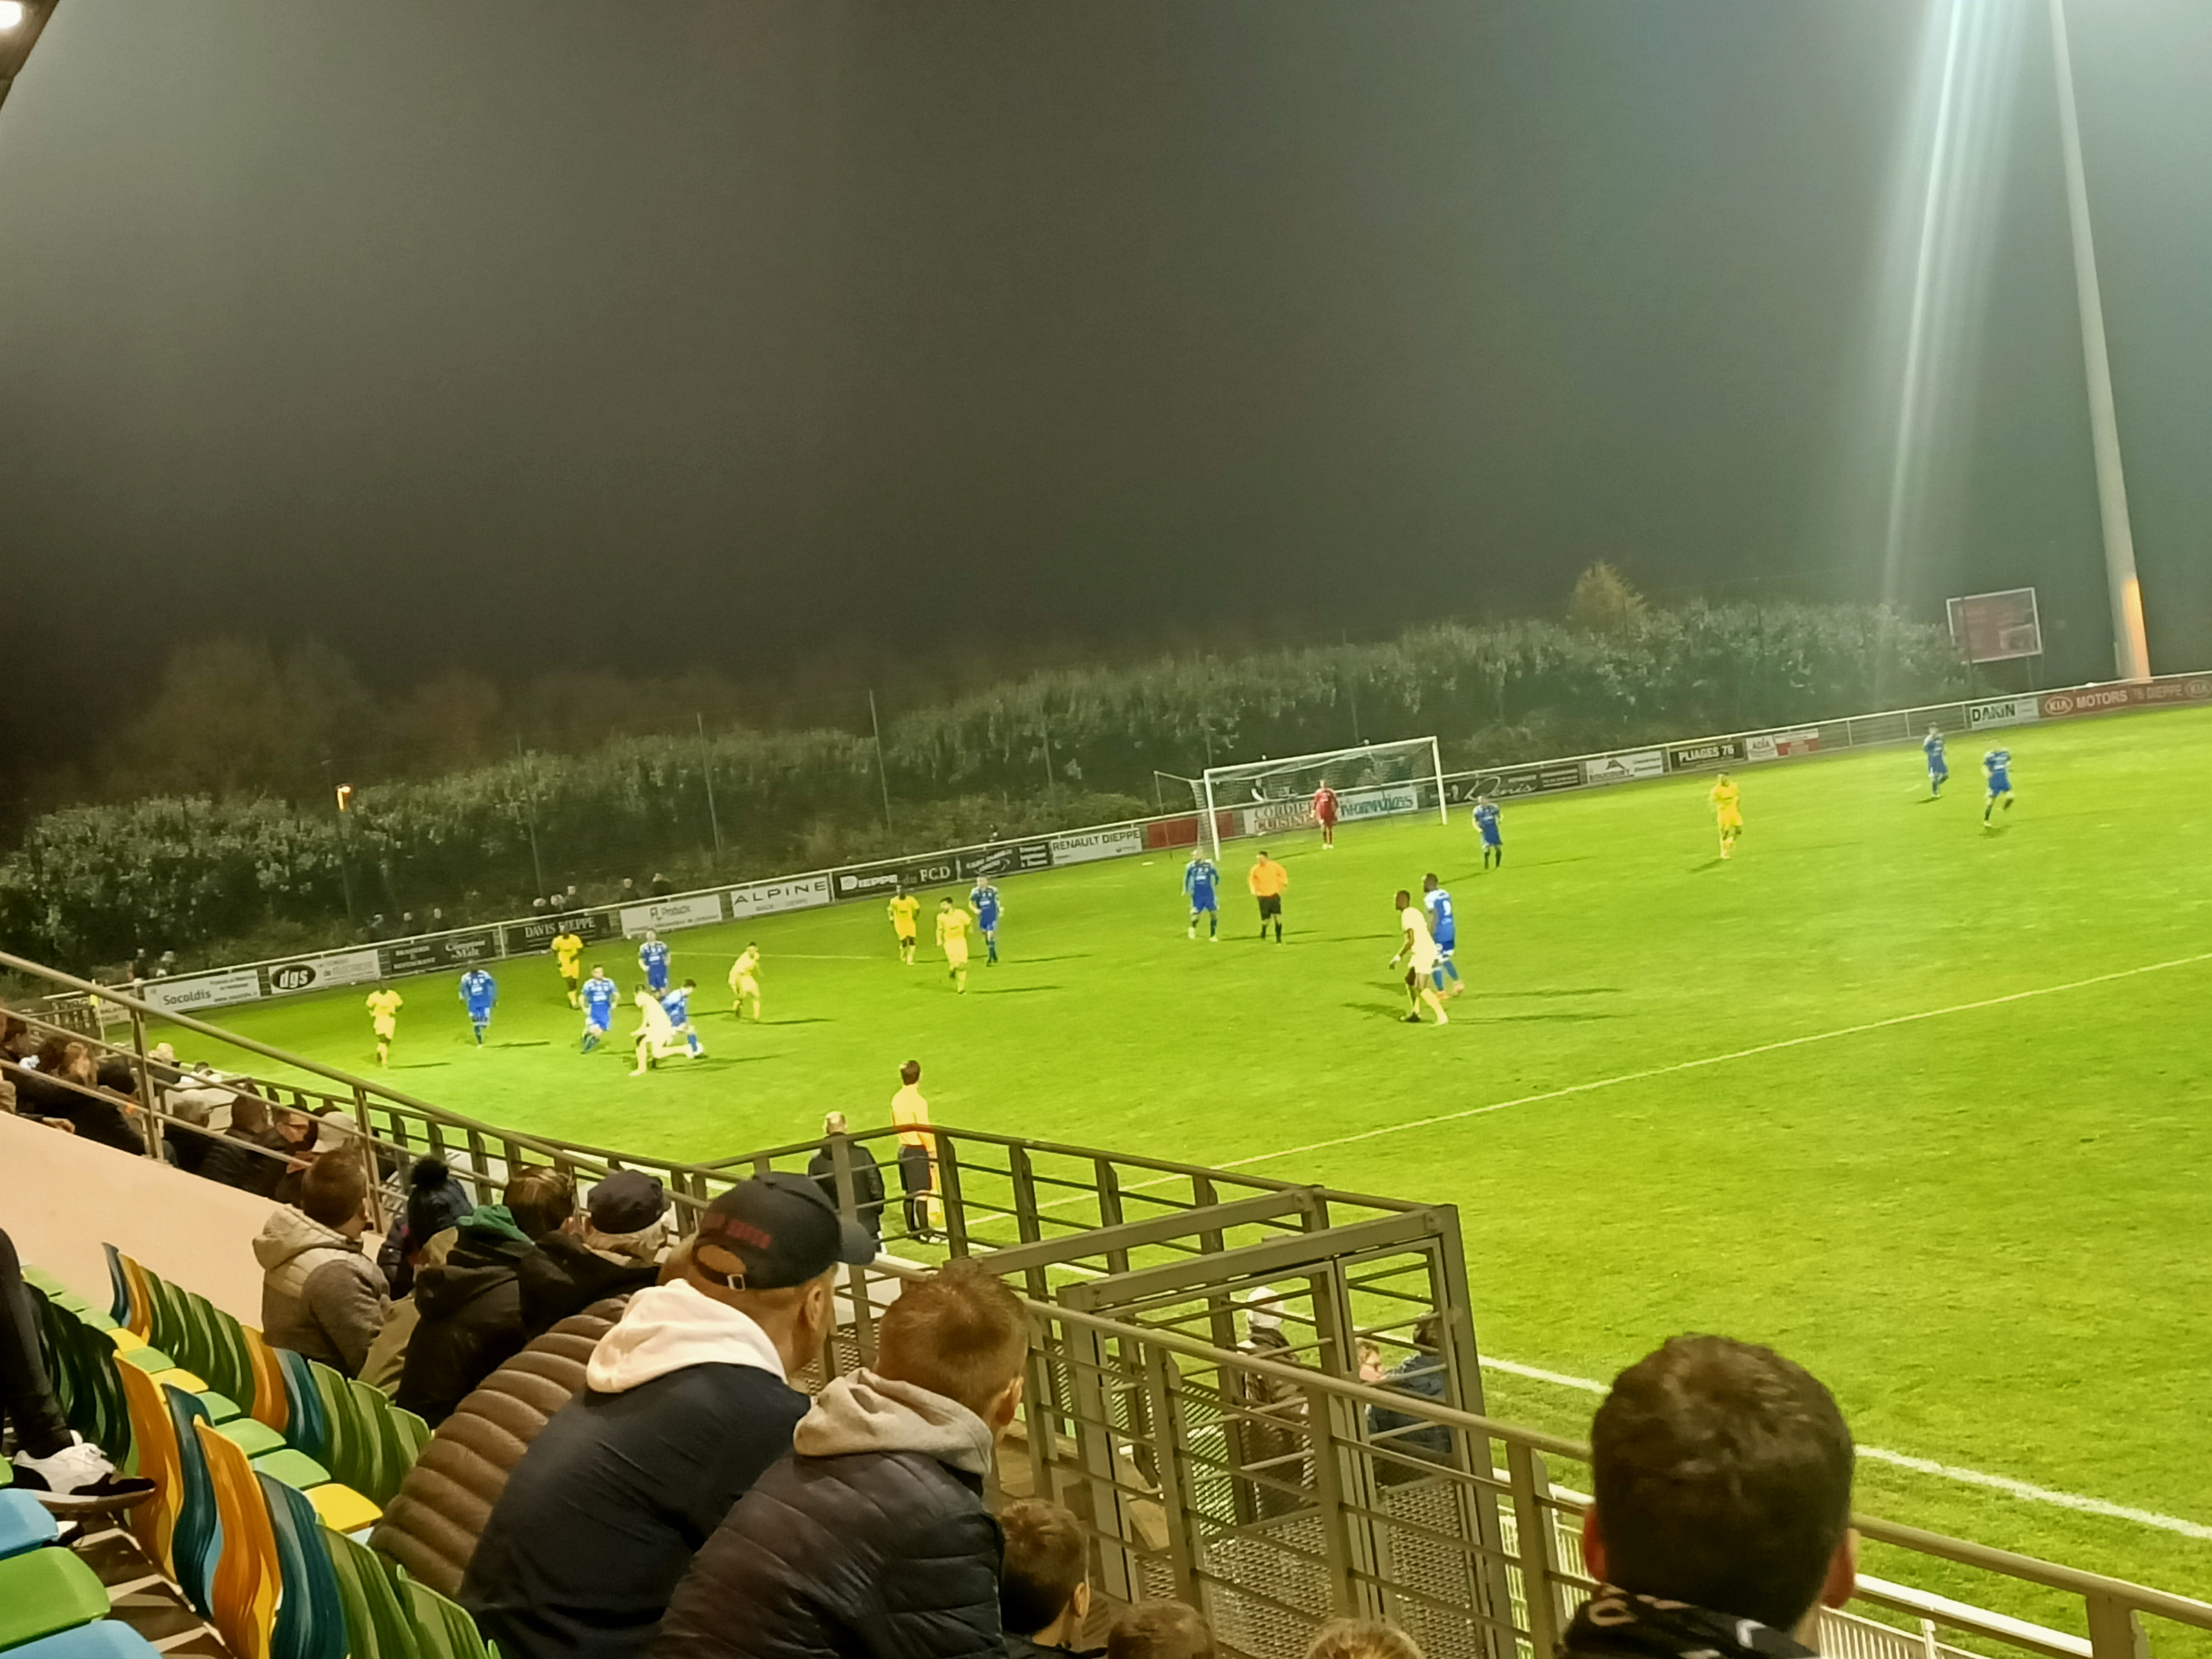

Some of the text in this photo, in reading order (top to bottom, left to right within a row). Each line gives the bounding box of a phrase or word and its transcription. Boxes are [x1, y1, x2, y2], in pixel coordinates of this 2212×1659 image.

[2077, 690, 2127, 708] MOTORS
[1678, 745, 1720, 763] PLIAGES
[1052, 836, 1100, 851] RENAULT
[1102, 831, 1140, 844] DIEPPE
[920, 866, 951, 881] FCD
[734, 881, 826, 905] ALPINE
[525, 923, 556, 938] DAVIS
[279, 970, 309, 989] dgs
[163, 989, 212, 1006] Socoldis
